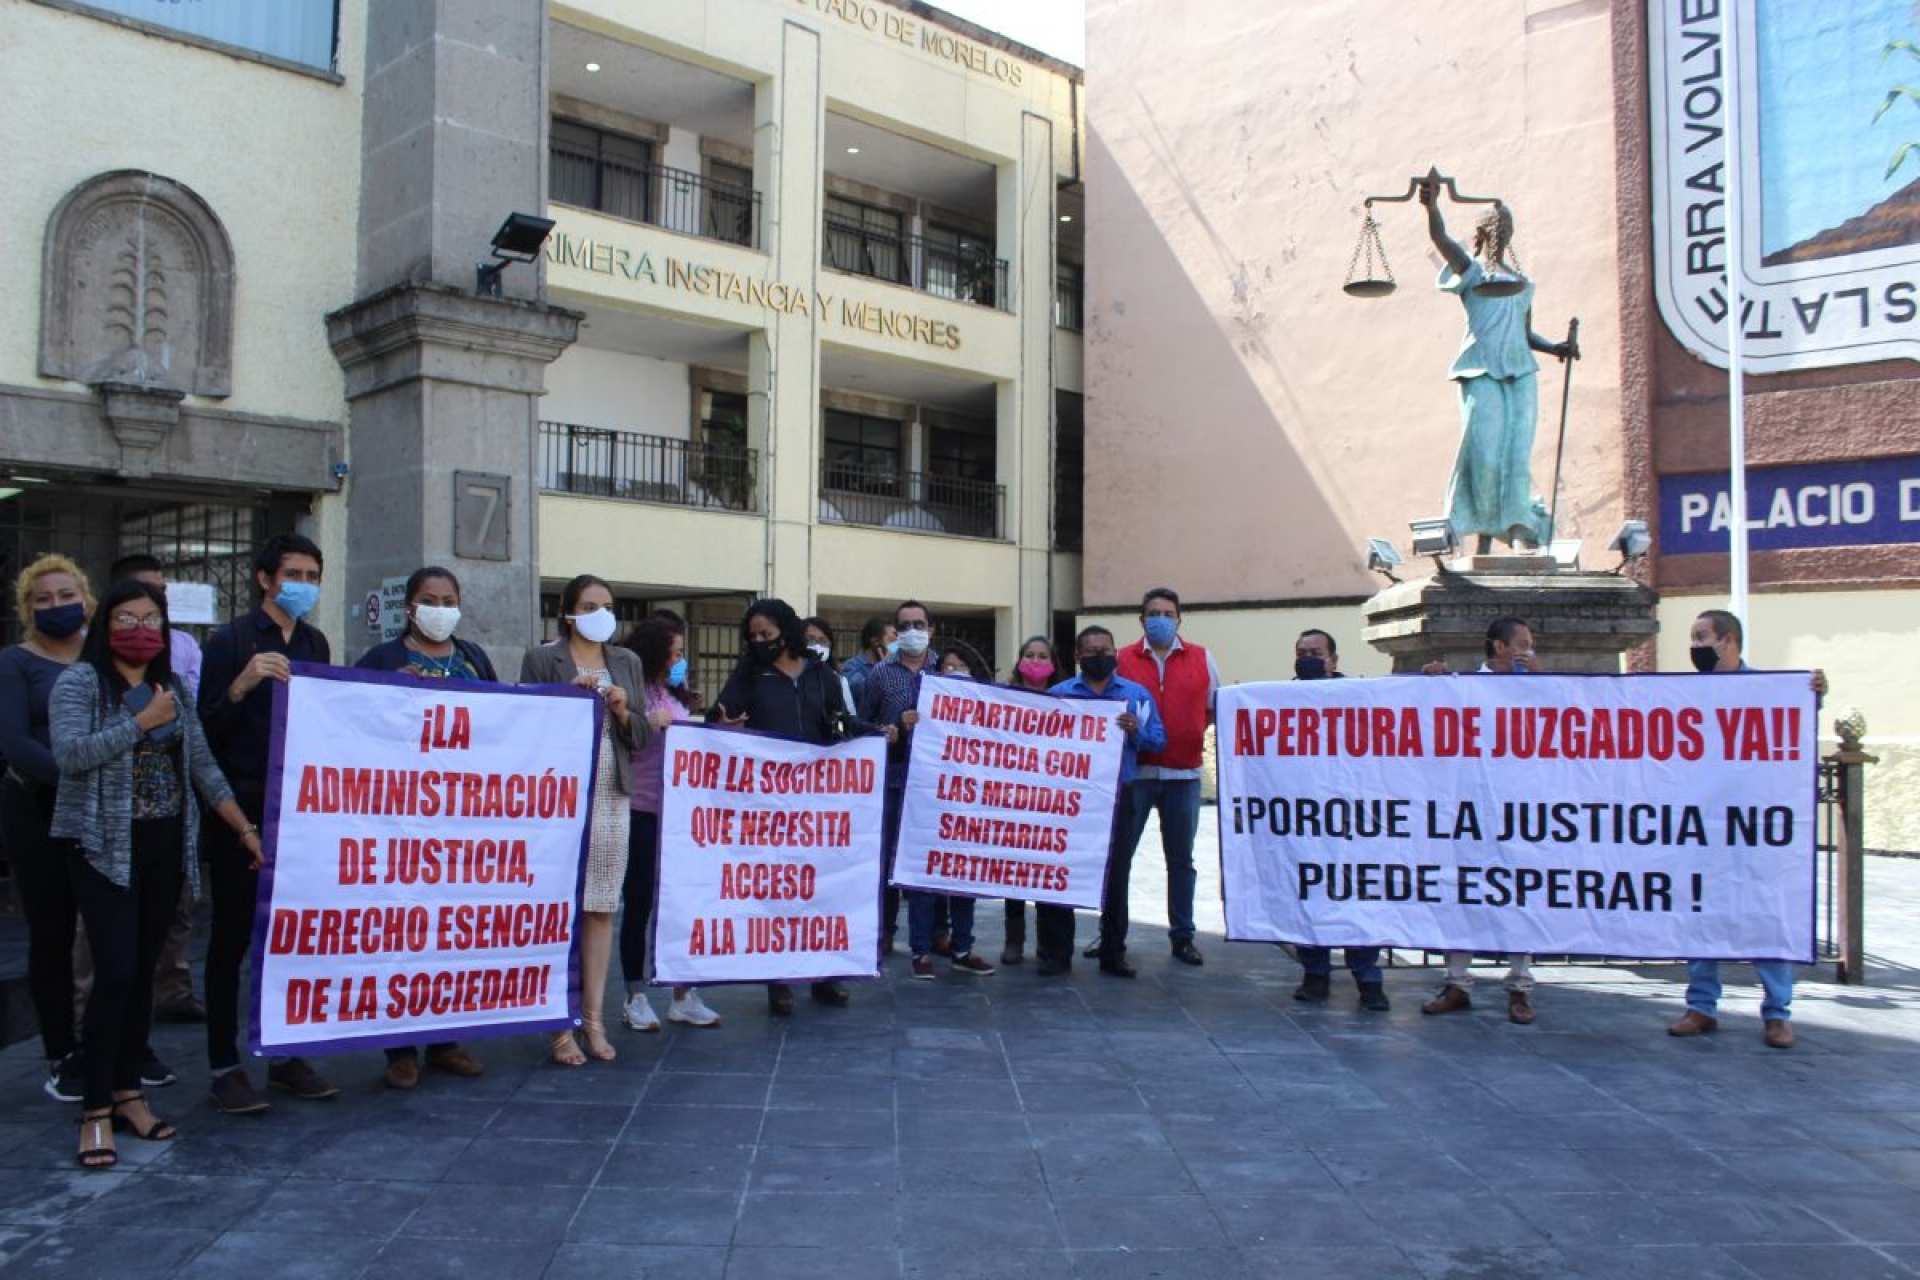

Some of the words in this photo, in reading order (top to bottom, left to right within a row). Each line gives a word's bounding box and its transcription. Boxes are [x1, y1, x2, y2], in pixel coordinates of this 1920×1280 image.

[884, 12, 915, 46] DE
[922, 26, 1022, 87] MORELOS
[666, 256, 809, 318] INSTANCIA
[816, 292, 833, 322] Y
[841, 299, 961, 351] MENORES
[1792, 286, 1870, 335] LA
[466, 485, 501, 545] 7
[420, 704, 471, 753] ¡LA
[931, 694, 1076, 740] IMPARTICIÓN
[1080, 713, 1108, 743] DE
[1234, 707, 1423, 757] APERTURA
[1434, 707, 1481, 757] DE
[1493, 707, 1704, 761] JUZGADOS
[1717, 707, 1800, 761] YA!!
[672, 750, 721, 789] POR
[726, 757, 754, 792] LA
[761, 758, 874, 794] SOCIEDAD
[941, 735, 1039, 773] JUSTICIA
[1045, 749, 1092, 780] CON
[297, 766, 578, 818] ADMINISTRACIÓN
[936, 773, 977, 804] LAS
[981, 780, 1082, 817] MEDIDAS
[690, 806, 735, 848] QUE
[740, 811, 850, 846] NECESITA
[938, 812, 1068, 854] SANITARIAS
[1232, 797, 1411, 841] ¡PORQUE
[1427, 801, 1482, 841] LA
[1497, 802, 1708, 846] JUSTICIA
[1727, 806, 1793, 847] NO
[339, 838, 377, 885] DE
[384, 839, 535, 888] JUSTICIA,
[720, 863, 816, 901] ACCESO
[925, 850, 1070, 892] PERTINENTES
[1298, 863, 1441, 903] PUEDE
[1458, 866, 1671, 911] ESPERAR
[270, 906, 429, 955] DERECHO
[437, 903, 569, 950] ESENCIAL
[690, 918, 705, 954] A
[712, 919, 735, 954] LA
[746, 916, 848, 953] JUSTICIA
[286, 978, 331, 1025] DE
[338, 976, 378, 1021] LA
[387, 966, 549, 1019] SOCIEDAD!
